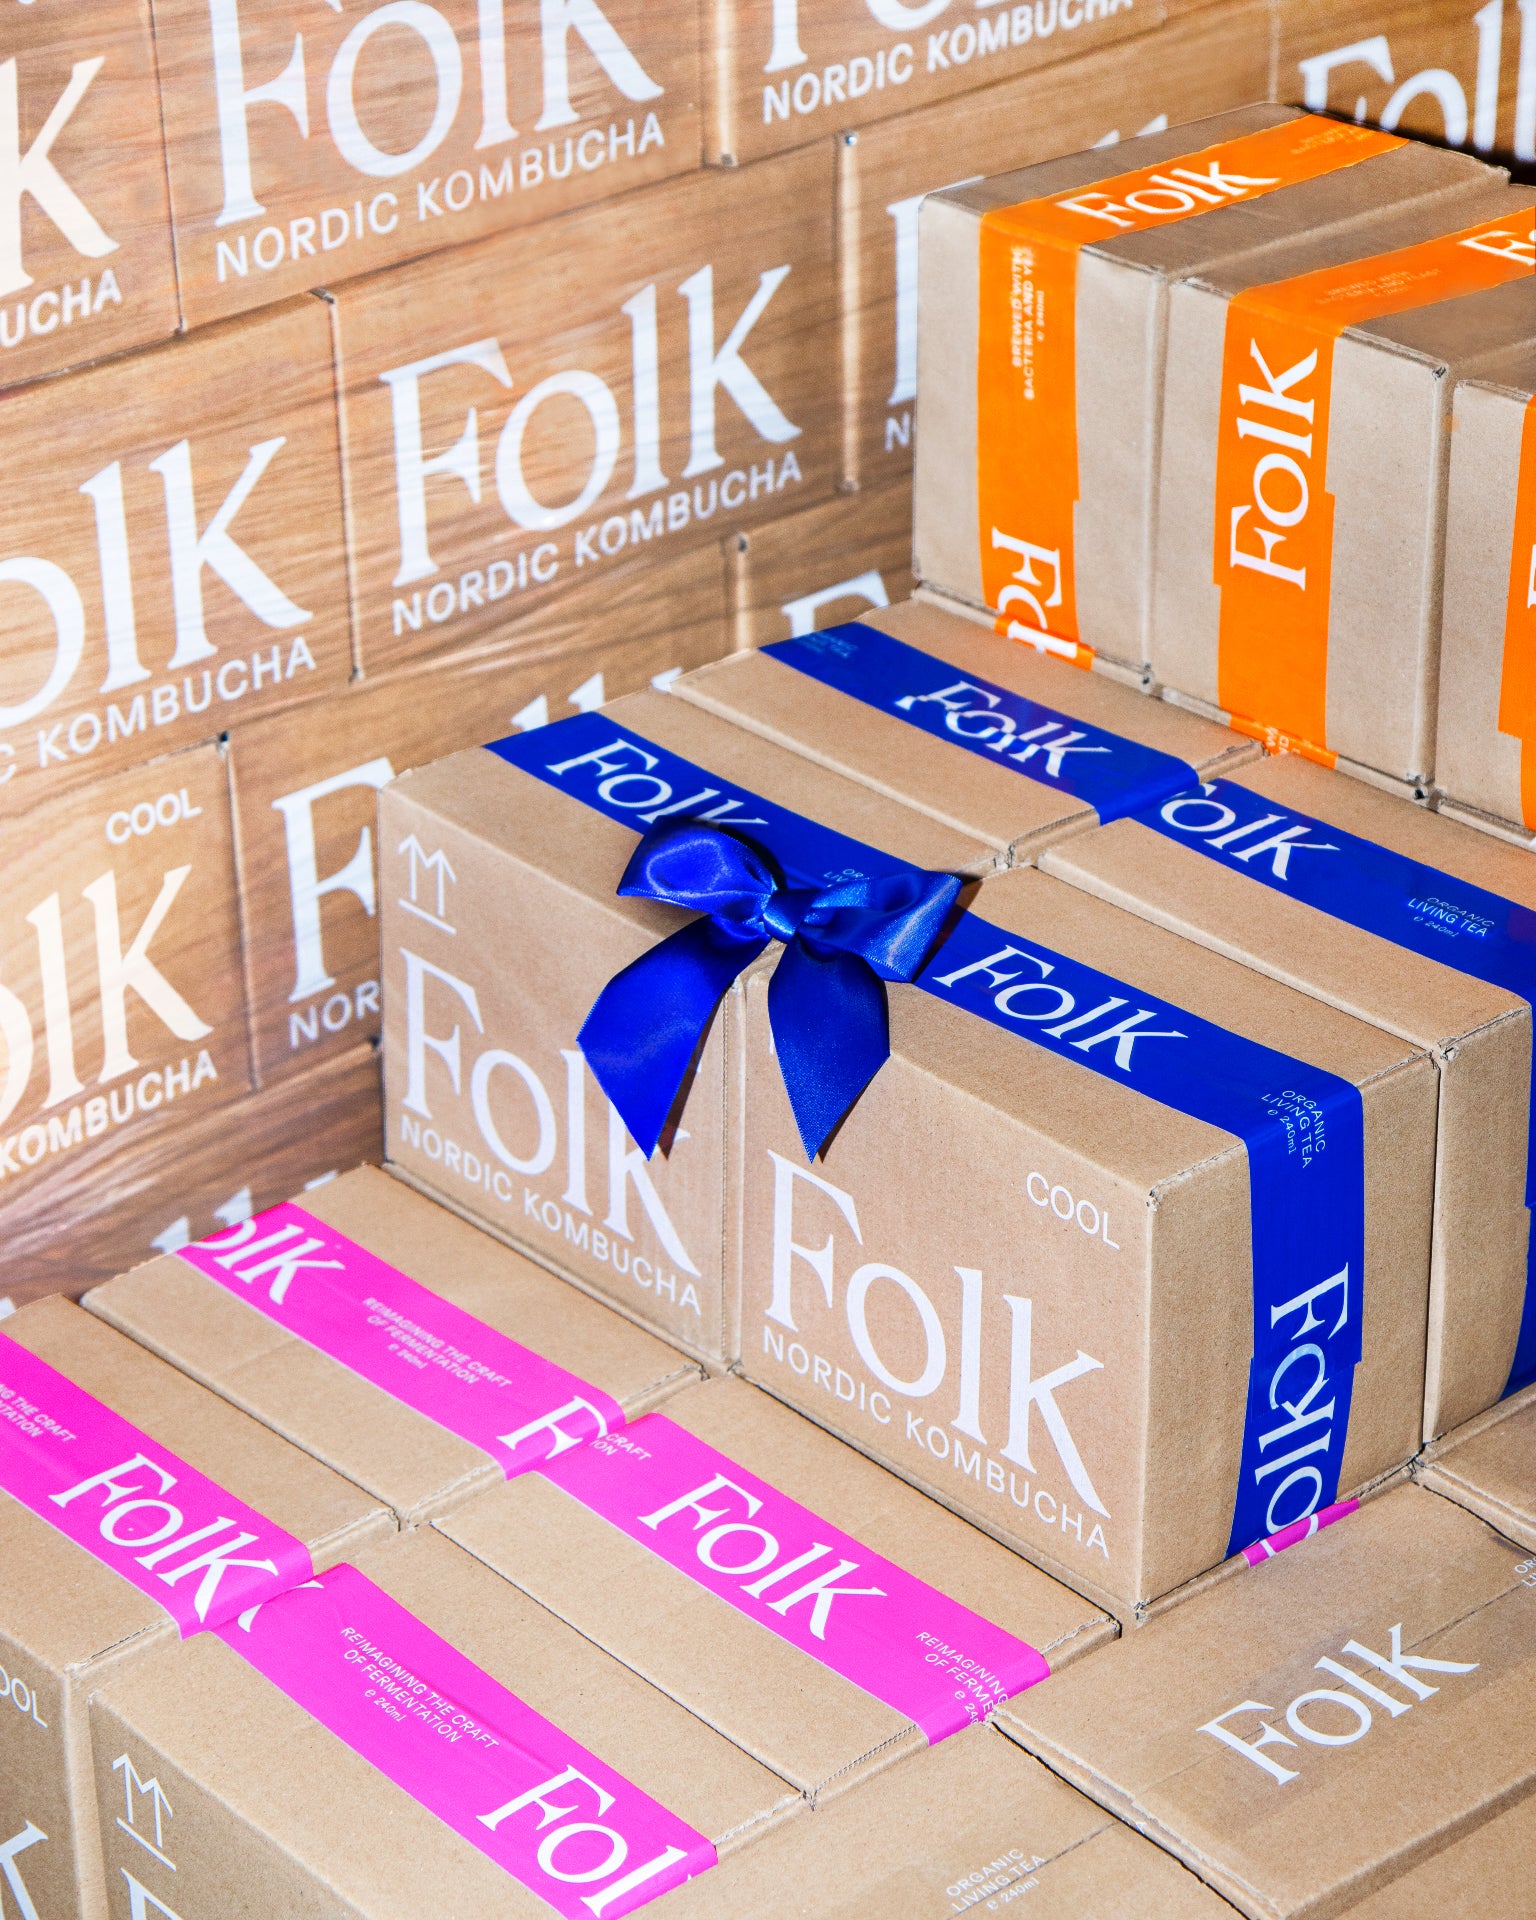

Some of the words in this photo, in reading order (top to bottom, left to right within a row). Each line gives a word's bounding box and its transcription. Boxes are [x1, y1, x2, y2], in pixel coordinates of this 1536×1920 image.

[214, 0, 665, 227] Folk
[762, 43, 914, 124] NORDIC
[216, 191, 399, 282] NORDIC
[416, 112, 665, 221] KOMBUCHA
[1055, 161, 1280, 228] Folk
[379, 264, 803, 588] Folk
[1229, 338, 1319, 592] Folk
[391, 543, 560, 637] NORDIC
[574, 451, 803, 567] KOMBUCHA
[37, 637, 317, 768] KOMBUCHA
[895, 680, 1113, 779] Folk
[105, 788, 203, 845] COOL
[1160, 783, 1341, 882] olk
[1407, 897, 1459, 925] LIVING
[1460, 918, 1488, 937] TEA
[1427, 897, 1495, 927] ORGANIC
[932, 944, 1189, 1072] Folk
[1261, 1093, 1310, 1131] LIVING
[1301, 1132, 1312, 1169] TEA
[1282, 1090, 1326, 1152] ORGANIC
[401, 1116, 512, 1202] NORDIC
[523, 1187, 701, 1315] KOMBUCHA
[1026, 1171, 1120, 1250] COOL
[384, 1325, 480, 1385] FERMENTATION
[443, 1345, 471, 1364] THE
[467, 1361, 513, 1388] CRAFT
[763, 1148, 1112, 1520] Folk
[11, 1396, 39, 1416] THE
[34, 1413, 77, 1442] CRAFT
[606, 1433, 652, 1461] CRAFT
[763, 1326, 892, 1425] NORDIC
[905, 1410, 1110, 1560] KOMBUCHA
[48, 1452, 279, 1623] Folk
[637, 1472, 888, 1640] Folk
[340, 1626, 428, 1695] REIMAGINING
[425, 1691, 456, 1716] THE
[451, 1714, 500, 1748] CRAFT
[343, 1649, 367, 1664] OF
[362, 1663, 463, 1743] FERMENTATION
[915, 1631, 1009, 1706] REIMAGINING
[925, 1653, 949, 1667] OF
[374, 1697, 407, 1723] 240ml
[1196, 1622, 1481, 1786] Folk
[475, 1764, 693, 1918] Fol
[945, 1848, 1025, 1897] ORGANIC
[950, 1875, 1012, 1914] LIVING
[1008, 1855, 1047, 1878] TEA
[1000, 1876, 1040, 1904] 240ml
